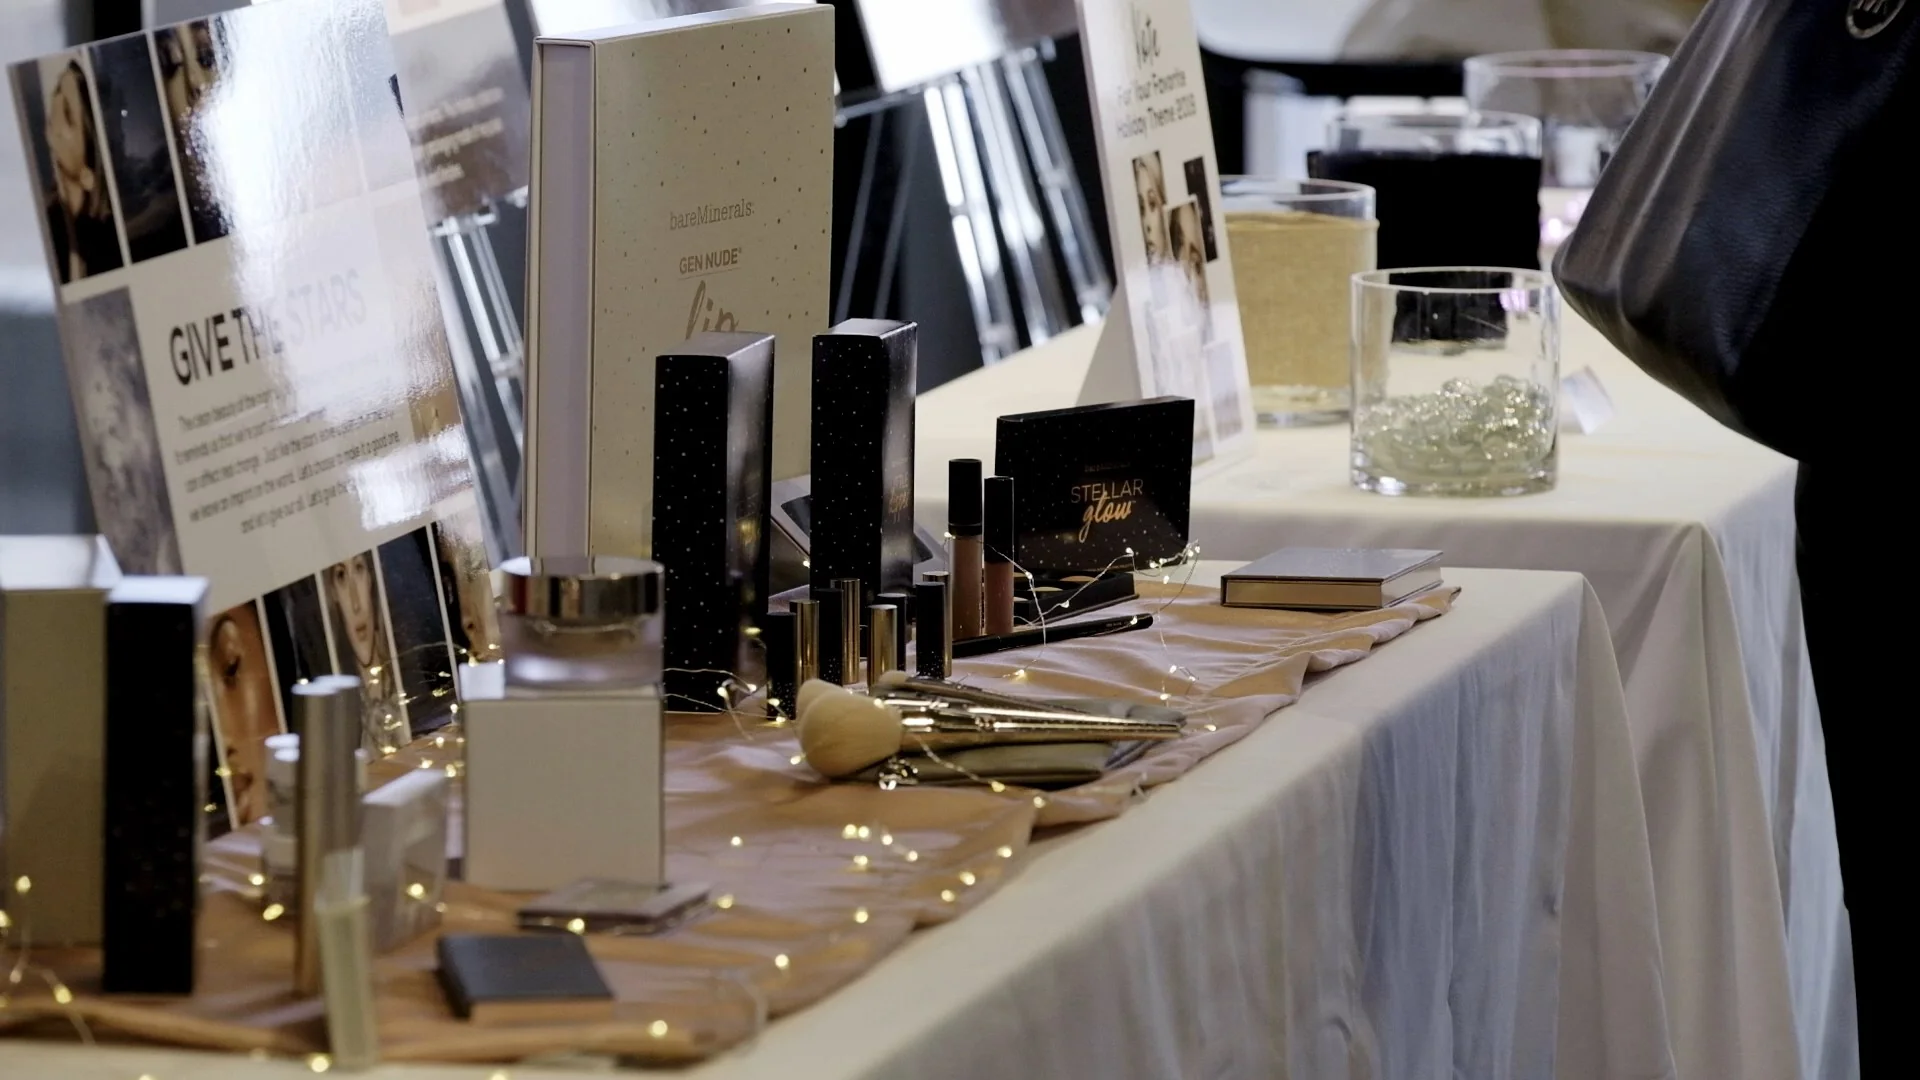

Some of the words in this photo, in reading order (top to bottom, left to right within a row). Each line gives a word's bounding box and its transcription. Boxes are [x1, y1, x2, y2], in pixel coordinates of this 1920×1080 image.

[679, 254, 703, 274] GEN
[170, 313, 234, 386] GIVE
[231, 298, 283, 364] THE
[285, 268, 367, 346] STARS
[1071, 478, 1144, 504] STELLAR
[1079, 490, 1132, 543] glow
